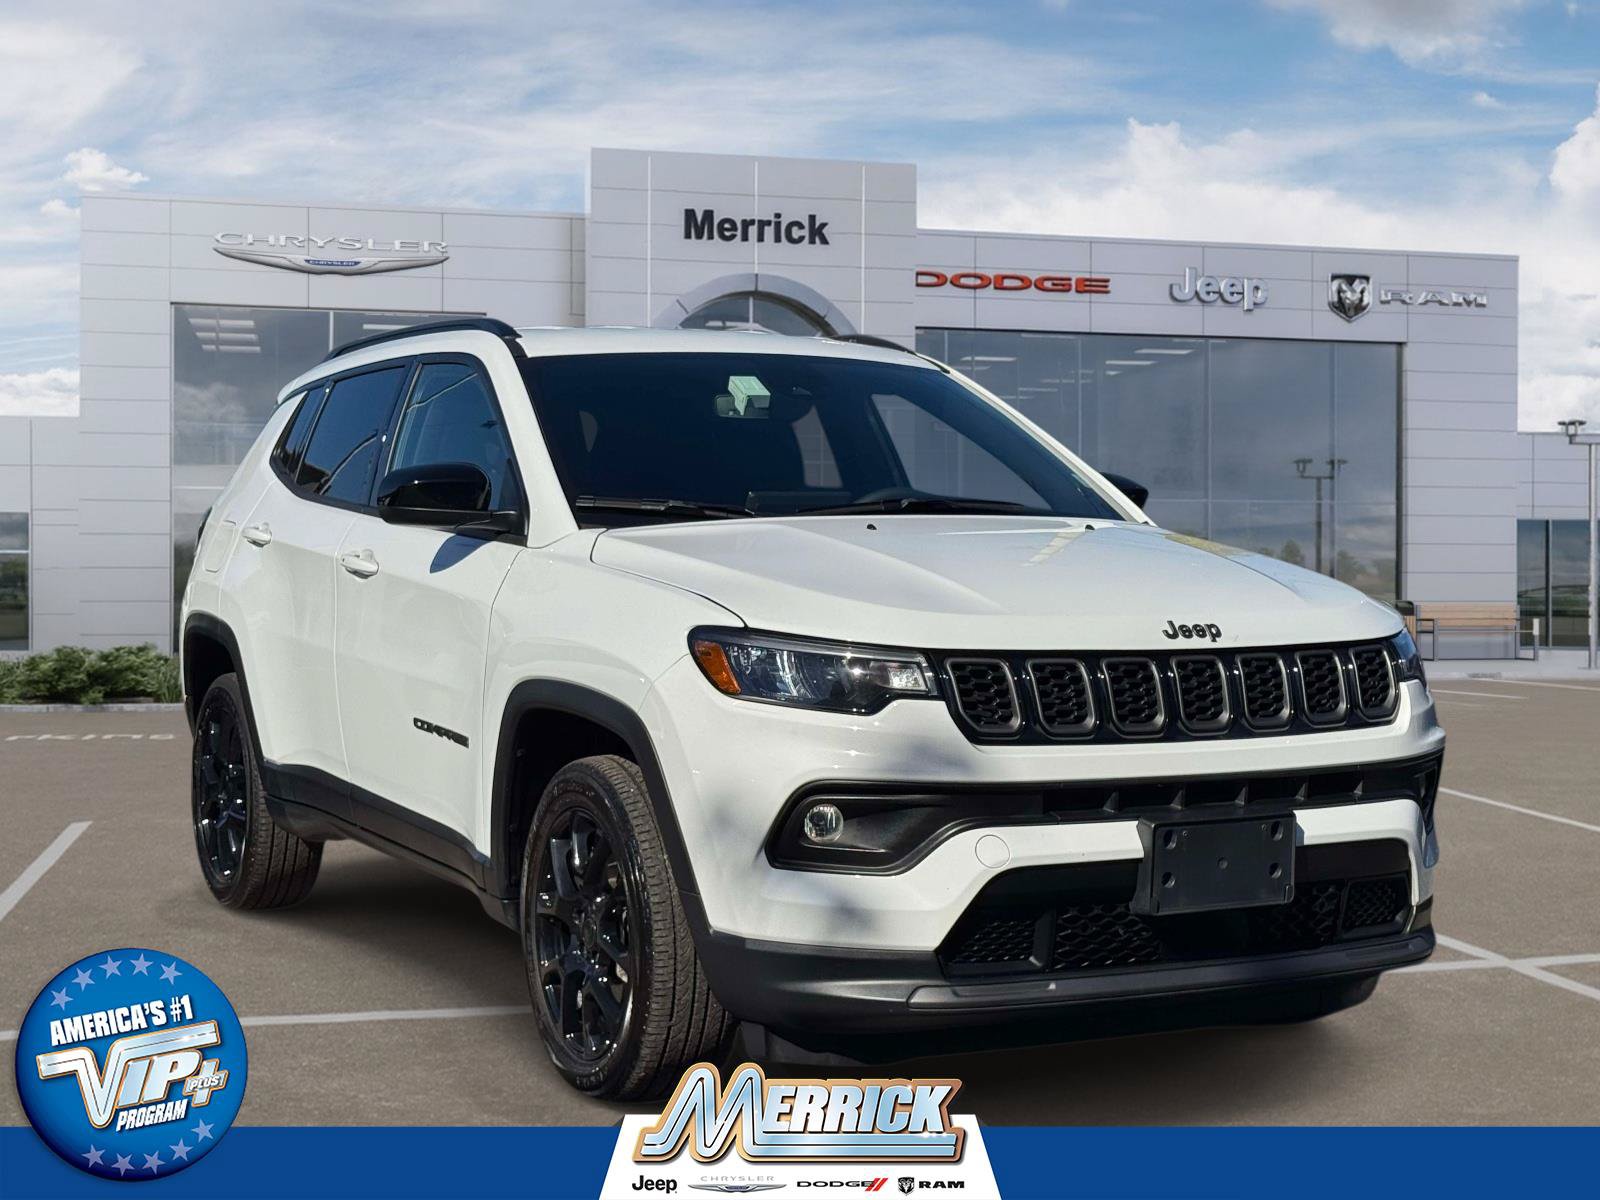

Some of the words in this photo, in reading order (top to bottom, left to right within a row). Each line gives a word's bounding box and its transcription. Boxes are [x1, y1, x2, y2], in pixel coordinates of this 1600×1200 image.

[683, 208, 830, 246] Merrick
[213, 231, 449, 254] CHRYSLER
[915, 271, 1111, 294] DODGE
[1170, 267, 1268, 311] Jeep
[1380, 289, 1487, 308] RAM
[1162, 620, 1223, 643] Jeep
